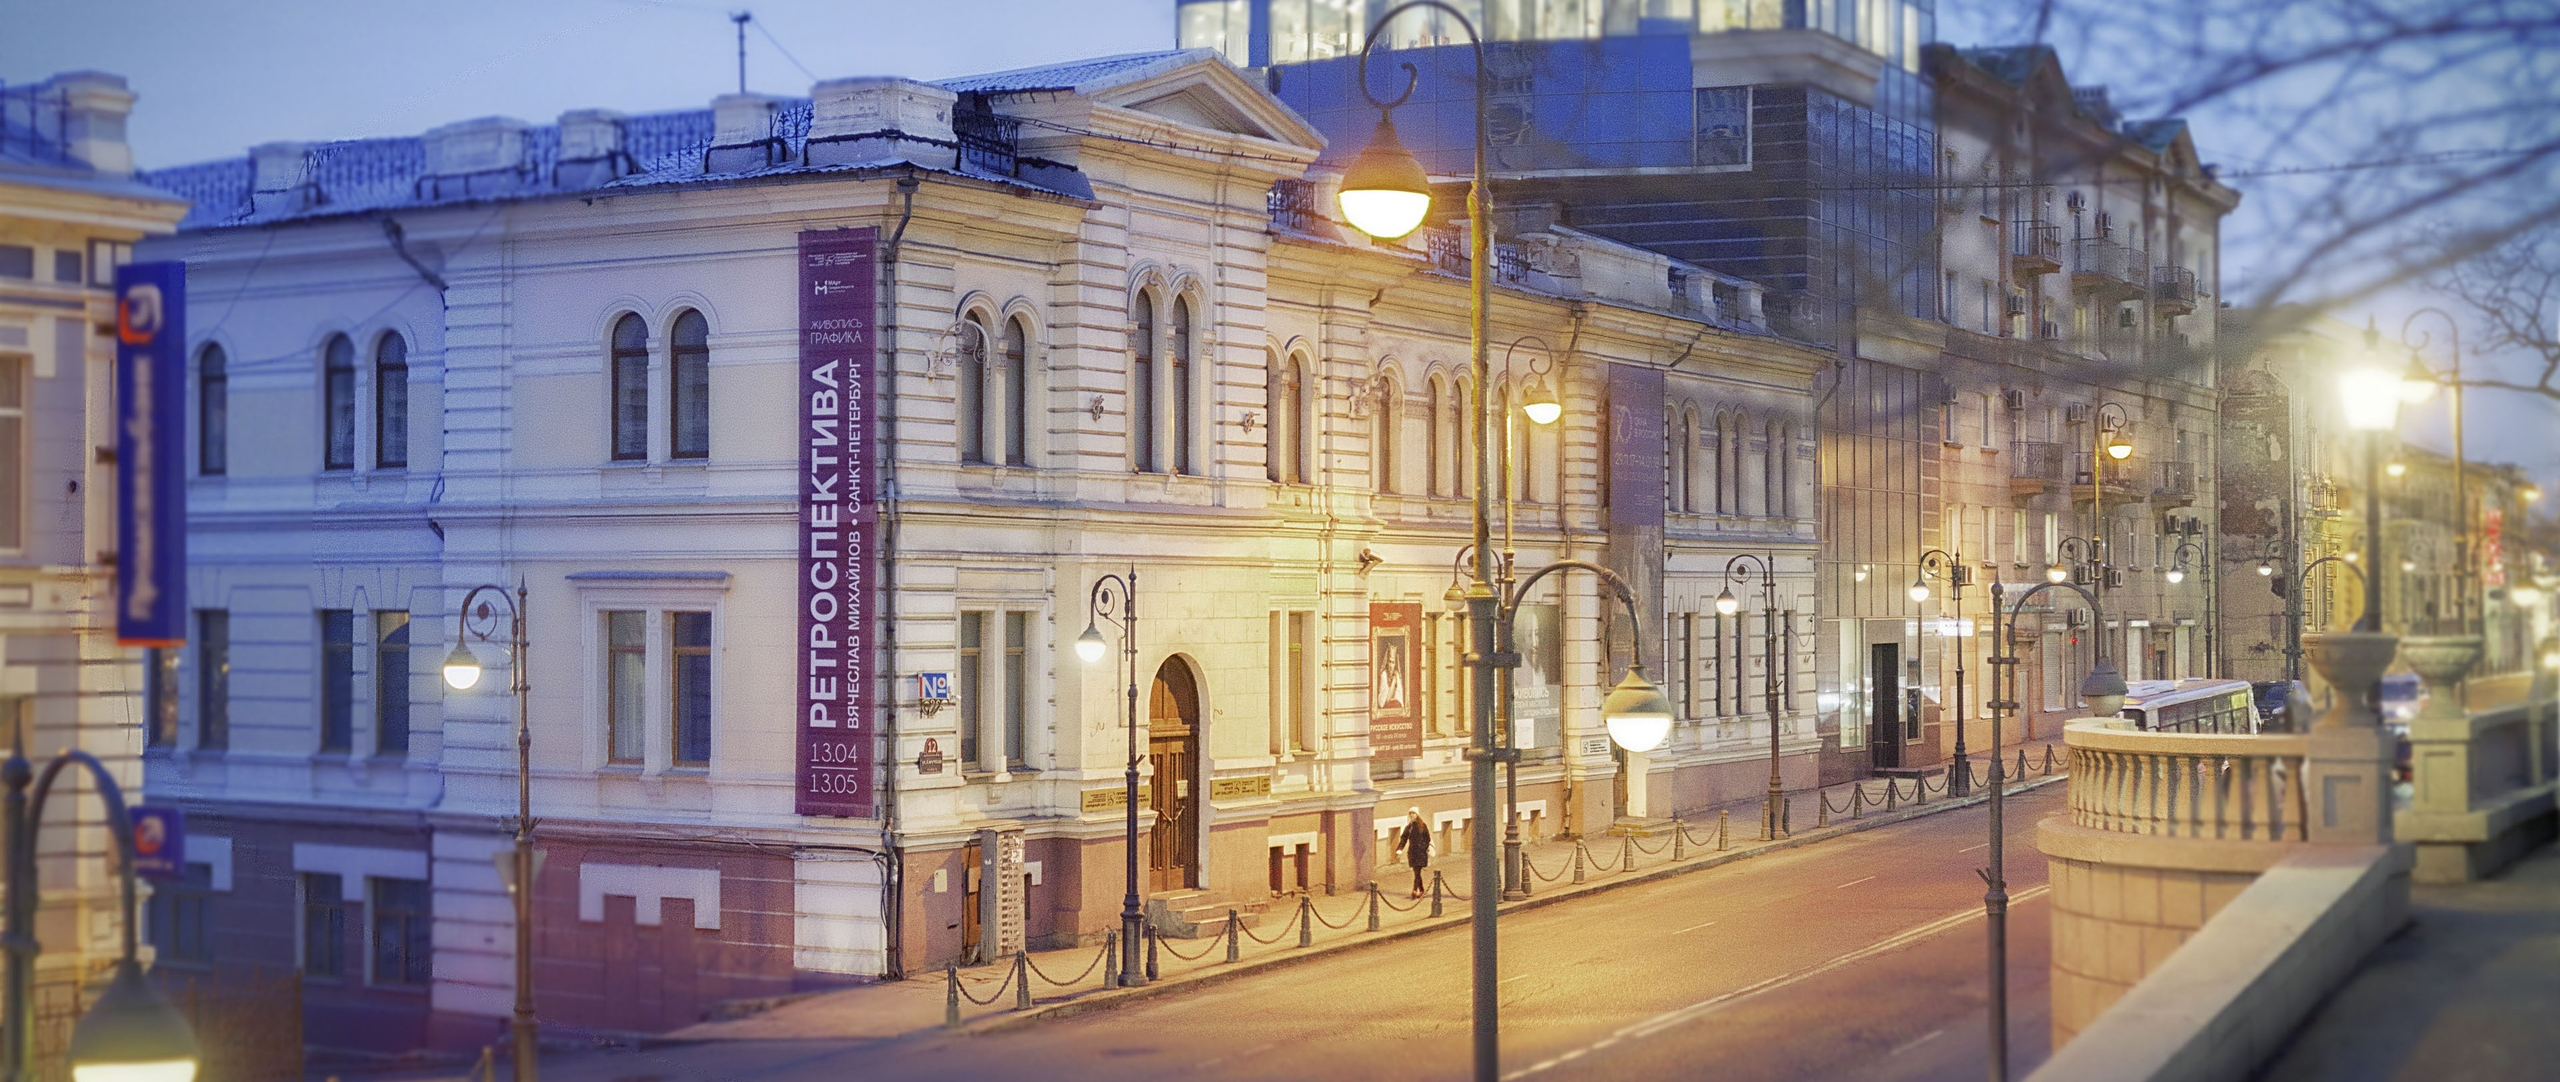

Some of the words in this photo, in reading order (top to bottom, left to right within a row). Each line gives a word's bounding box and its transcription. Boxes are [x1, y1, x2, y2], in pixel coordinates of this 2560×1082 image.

[810, 318, 863, 330] ЖИВОПИСЬ
[810, 330, 862, 344] ГРАФИКА
[848, 358, 861, 514] САНКТ-ПЕТЕРБУРГ
[810, 359, 839, 728] РЕТРОСПЕКТИВА
[845, 530, 861, 630] МИХАЙЛОВ
[847, 635, 860, 729] ВЯЧЕСЛАВ
[811, 743, 858, 764] 13.04
[927, 741, 937, 753] 12
[810, 774, 858, 795] 13.05
